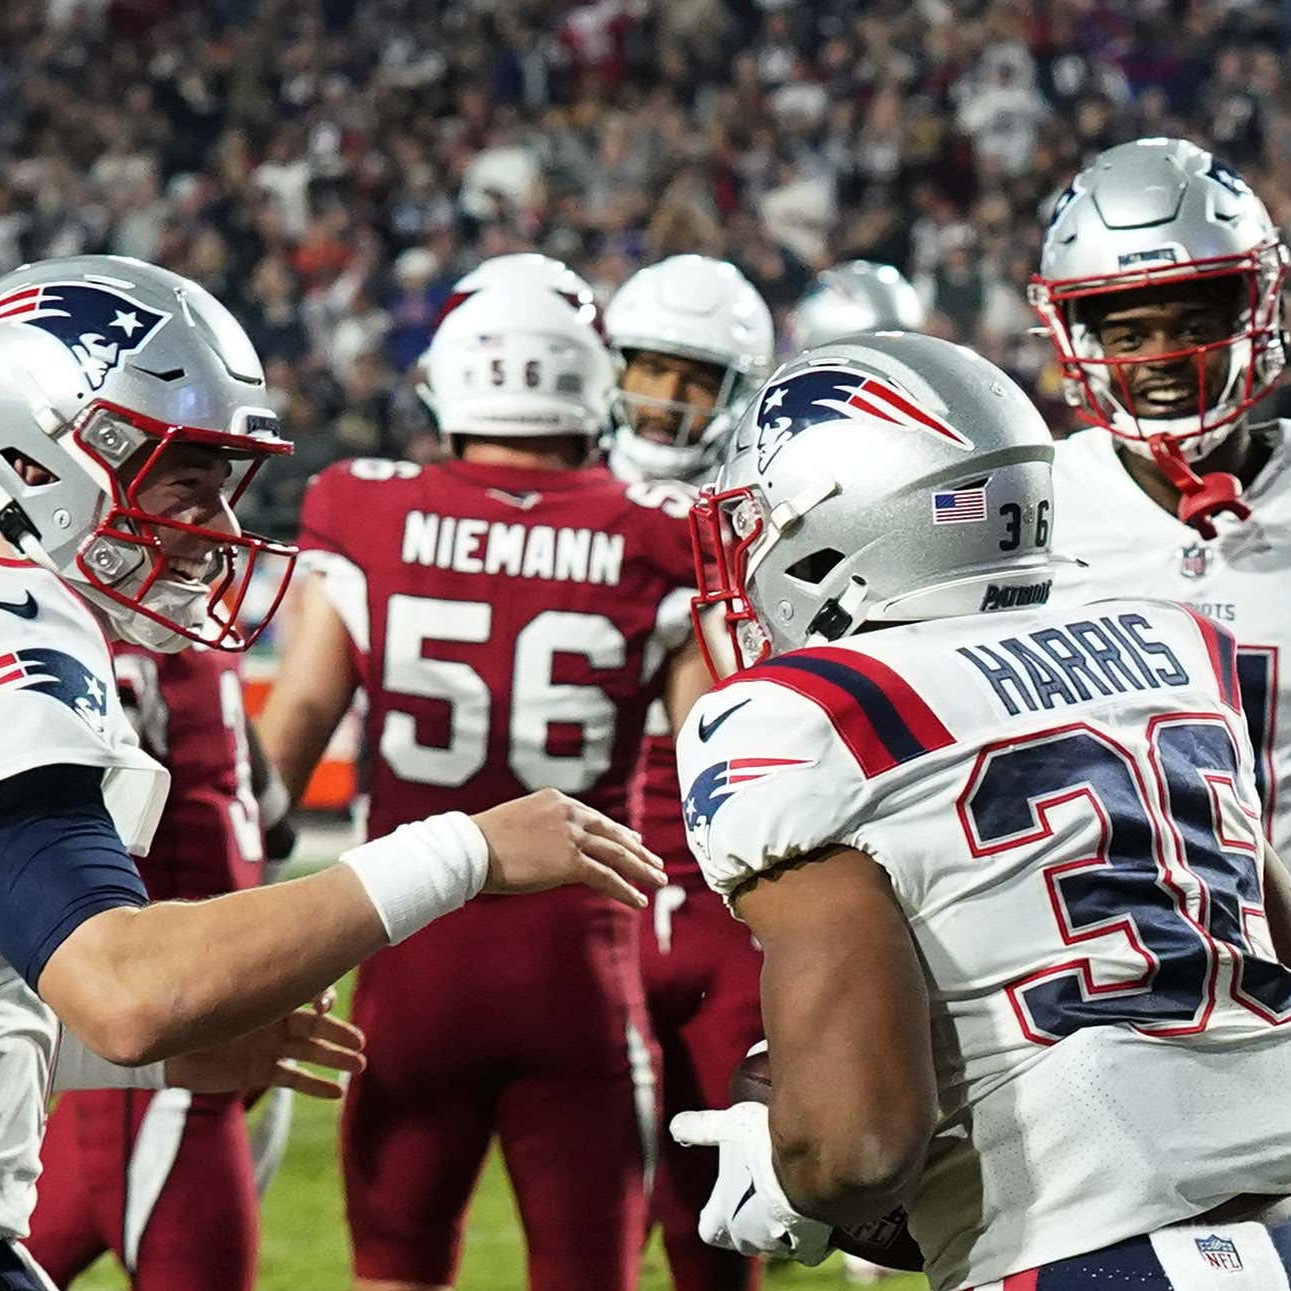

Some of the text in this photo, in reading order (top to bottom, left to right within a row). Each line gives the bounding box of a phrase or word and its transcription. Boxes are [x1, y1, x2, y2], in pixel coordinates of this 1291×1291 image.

[402, 510, 625, 586] NIEMANN
[379, 594, 626, 794] 56
[955, 613, 1190, 716] HARRIS
